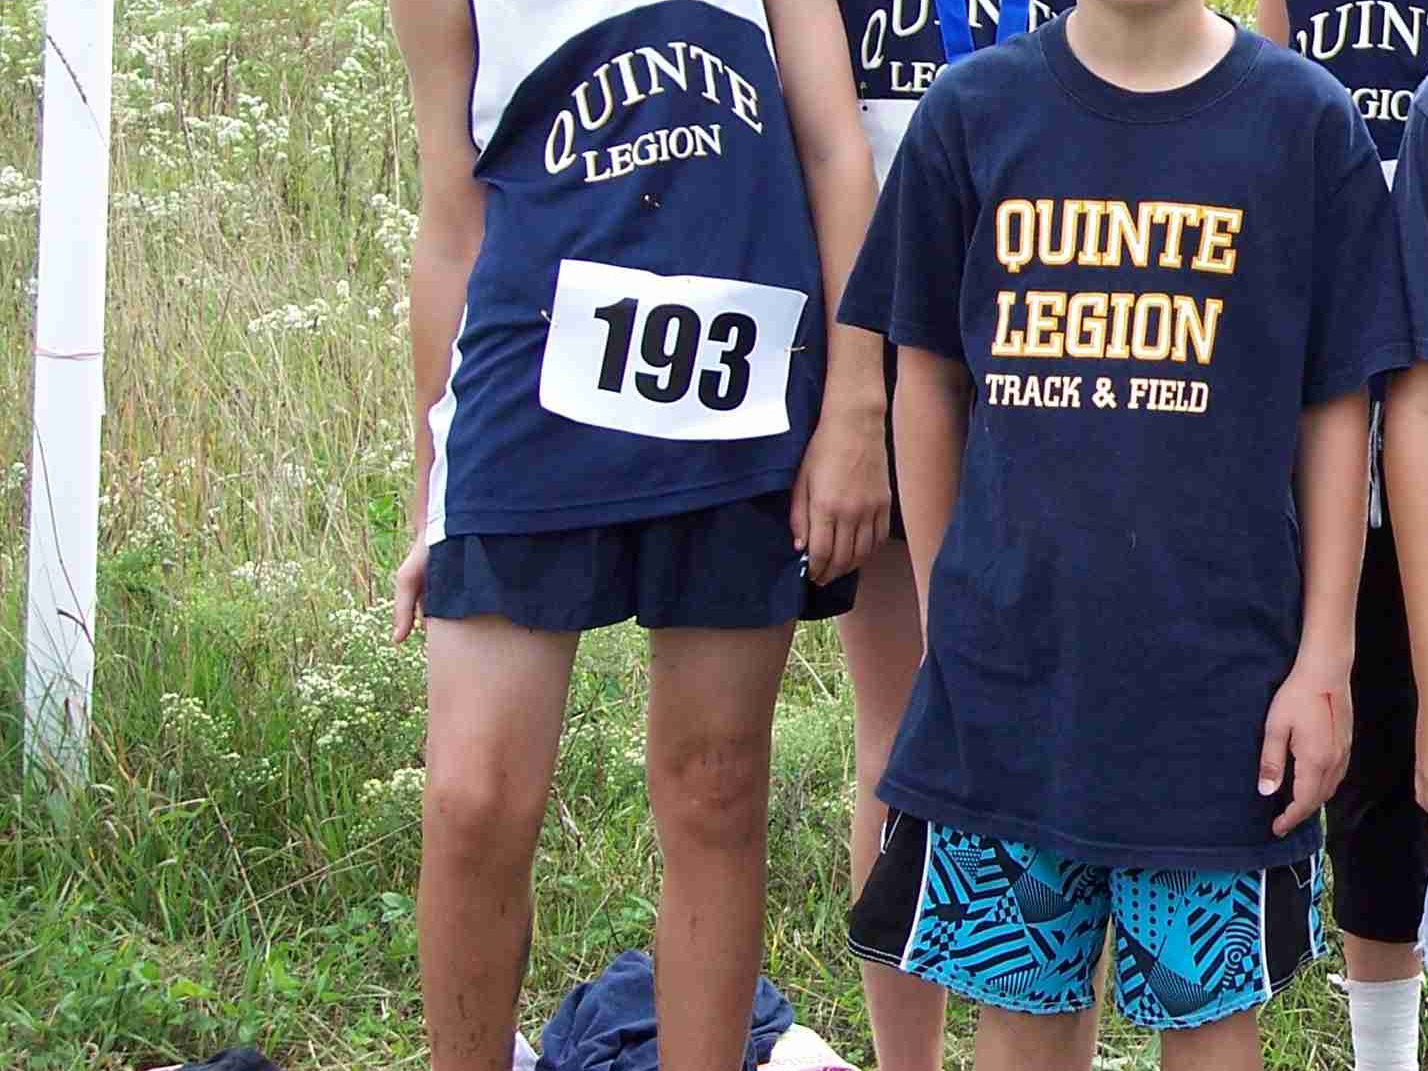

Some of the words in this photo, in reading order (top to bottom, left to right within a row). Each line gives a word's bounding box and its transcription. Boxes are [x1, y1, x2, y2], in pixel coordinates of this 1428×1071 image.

[544, 41, 763, 175] QUINTE
[581, 124, 722, 183] LEGION
[996, 199, 1243, 274] QUINTE
[593, 297, 757, 411] 193
[991, 291, 1224, 364] LEGION
[985, 373, 1082, 408] TRACK
[1092, 377, 1117, 409] &
[1128, 377, 1209, 413] FIELD
